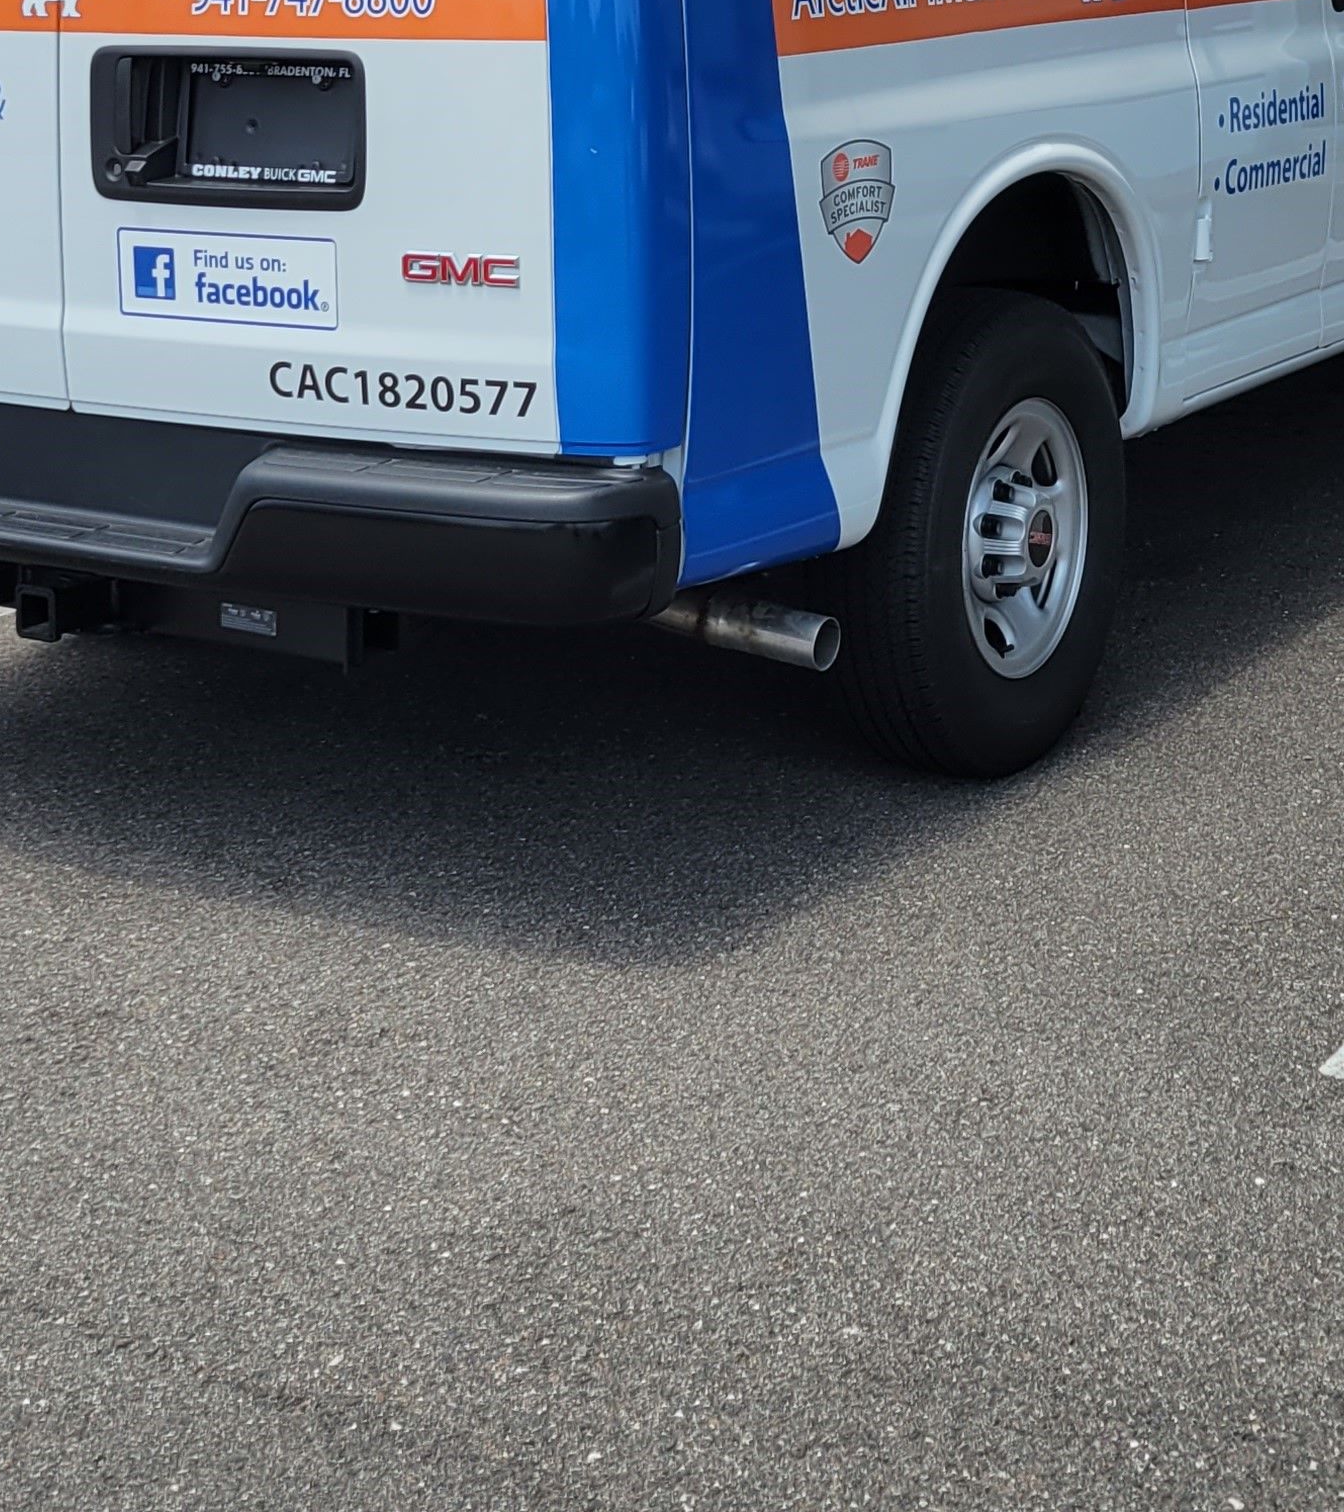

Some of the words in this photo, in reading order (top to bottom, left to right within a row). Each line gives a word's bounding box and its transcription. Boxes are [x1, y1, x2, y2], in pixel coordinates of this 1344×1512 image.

[339, 67, 351, 78] FL
[1230, 82, 1325, 133] Residential
[192, 164, 262, 179] CONLEY
[264, 168, 296, 181] BUICK
[298, 170, 337, 183] GMC
[852, 155, 880, 170] TRANE
[1225, 140, 1326, 195] Commercial
[833, 186, 882, 207] COMFORT
[831, 201, 887, 224] SPECIALIST
[194, 249, 229, 269] Find
[235, 256, 254, 270] us
[260, 259, 287, 273] on:
[401, 250, 521, 288] GMC
[195, 272, 321, 312] facebook
[269, 361, 538, 418] CAC1820577
